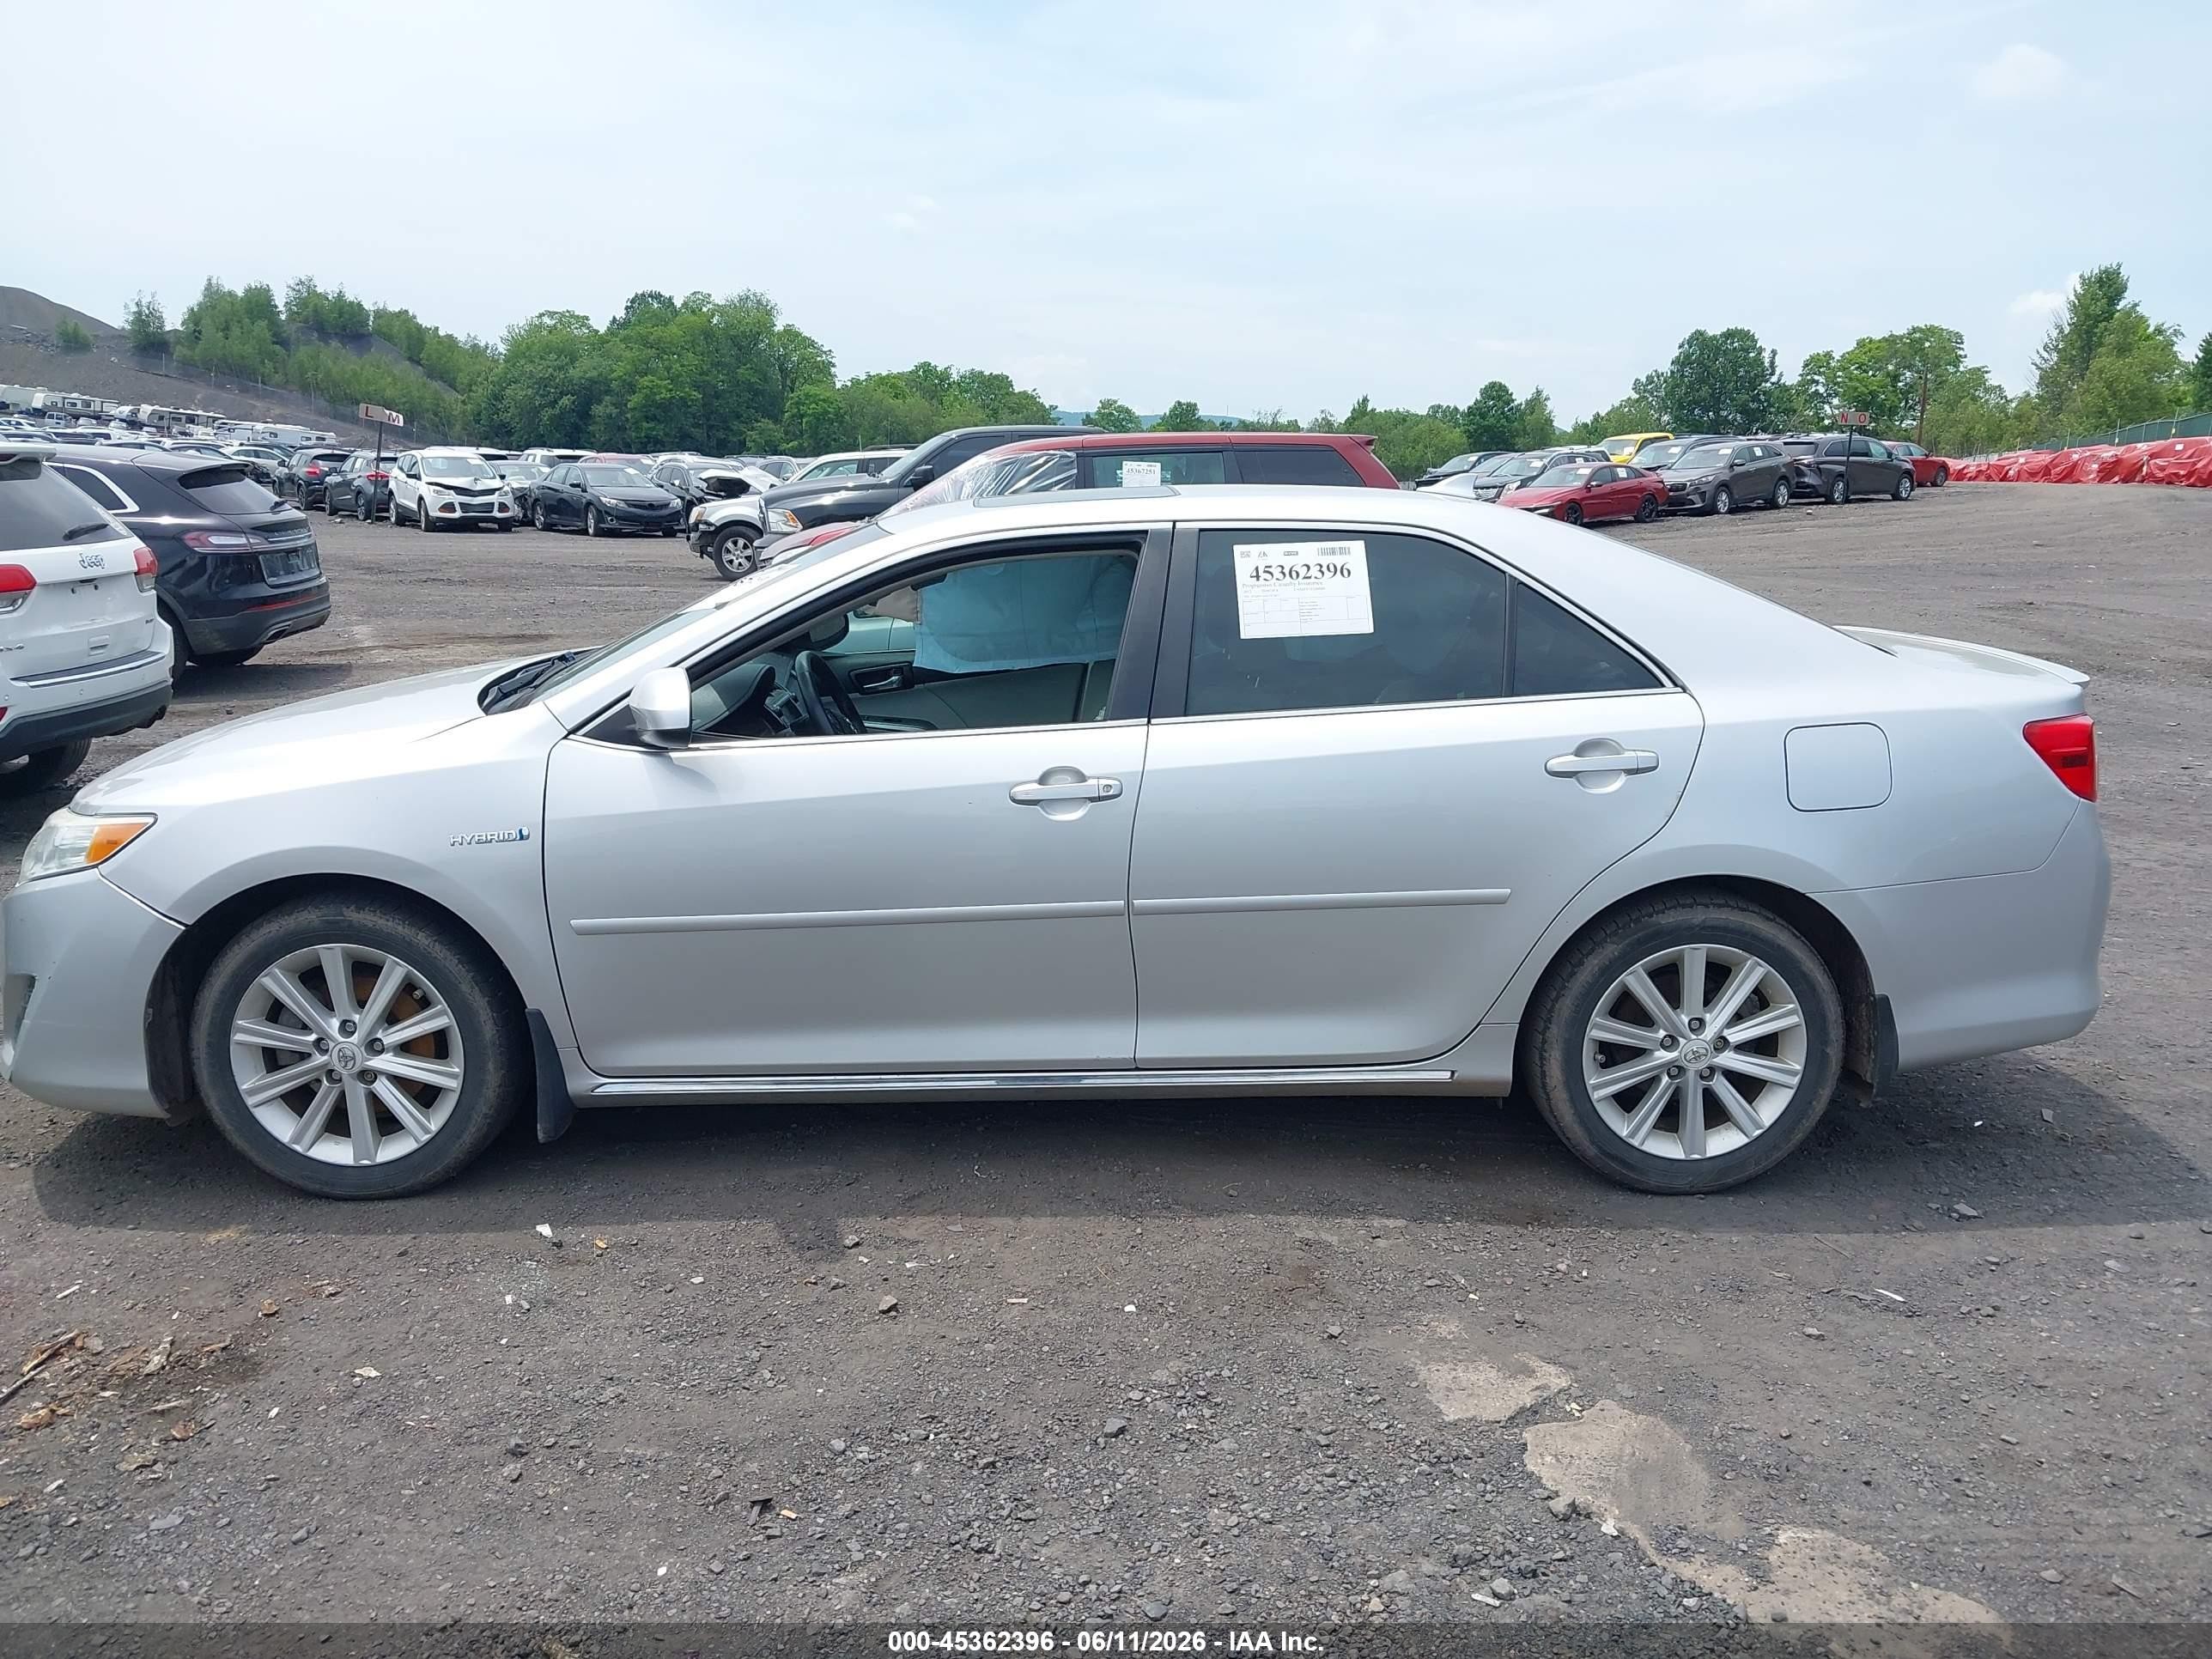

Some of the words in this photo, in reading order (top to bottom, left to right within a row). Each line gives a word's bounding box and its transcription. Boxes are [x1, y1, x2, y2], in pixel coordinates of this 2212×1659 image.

[364, 405, 374, 418] L
[387, 411, 400, 424] M
[1840, 413, 1849, 423] N
[79, 552, 106, 569] Jeep
[1249, 562, 1352, 581] 45362396
[449, 830, 517, 847] HYBRID
